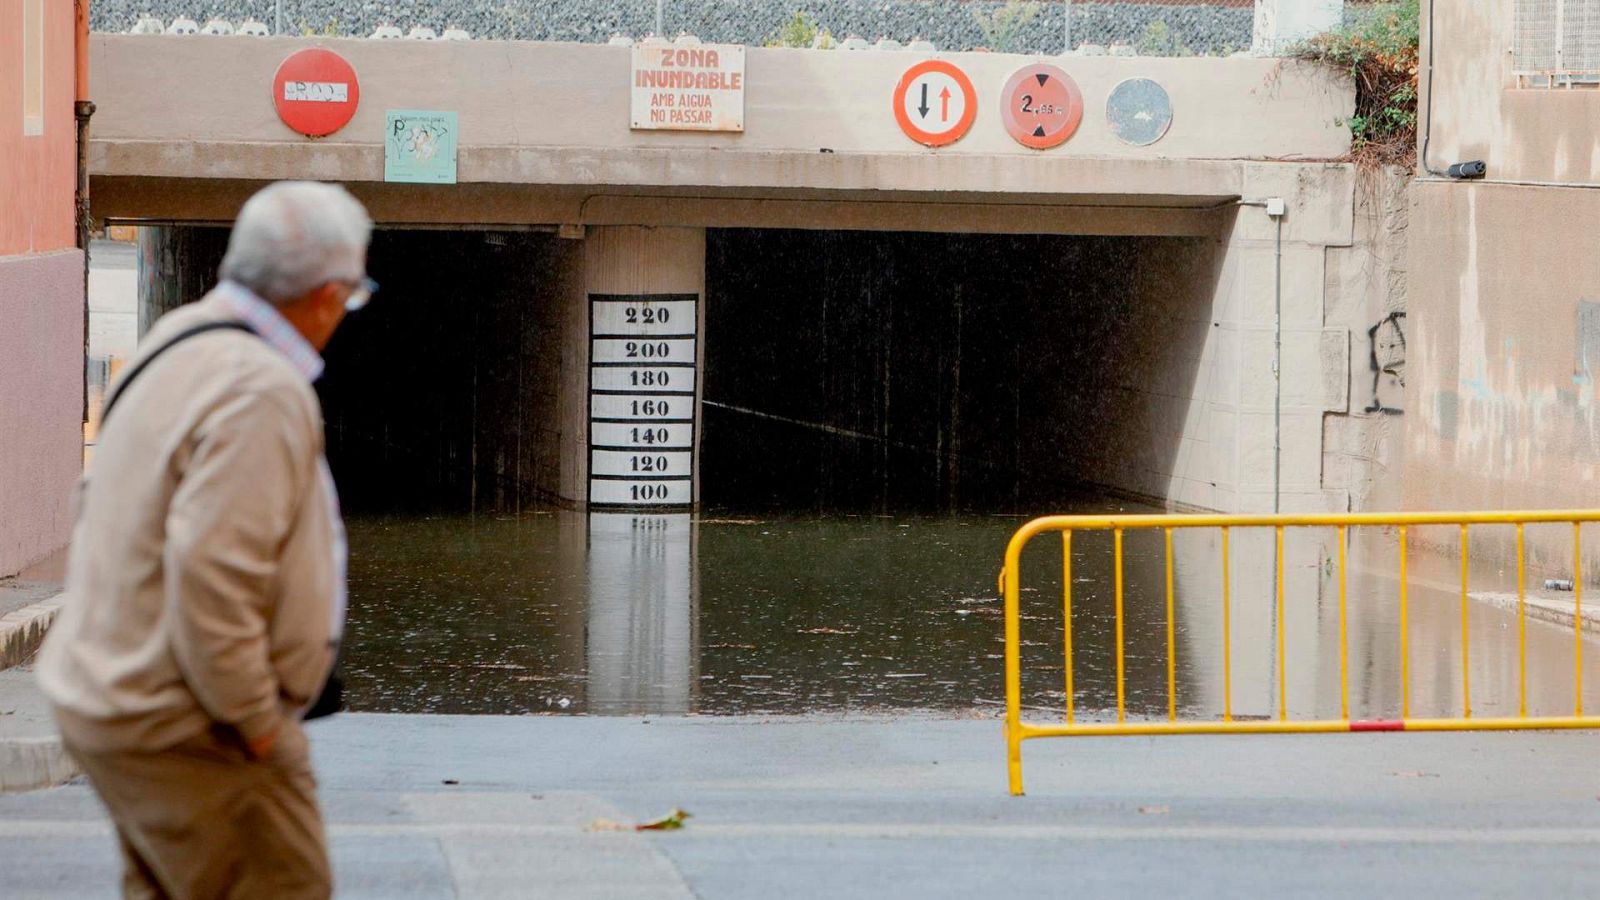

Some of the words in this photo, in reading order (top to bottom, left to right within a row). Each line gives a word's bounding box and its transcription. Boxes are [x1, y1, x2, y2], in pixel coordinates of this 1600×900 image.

[661, 49, 719, 68] ZONA
[635, 69, 742, 90] INUNDABLE
[651, 93, 675, 107] AMB
[679, 94, 712, 108] AIGUA
[650, 109, 666, 123] NO
[670, 109, 712, 124] PASSAR
[625, 307, 669, 324] 220
[625, 342, 669, 358] 200
[630, 370, 669, 387] 180
[630, 400, 669, 417] 160
[630, 427, 669, 444] 140
[630, 456, 668, 472] 120
[630, 484, 668, 501] 100
